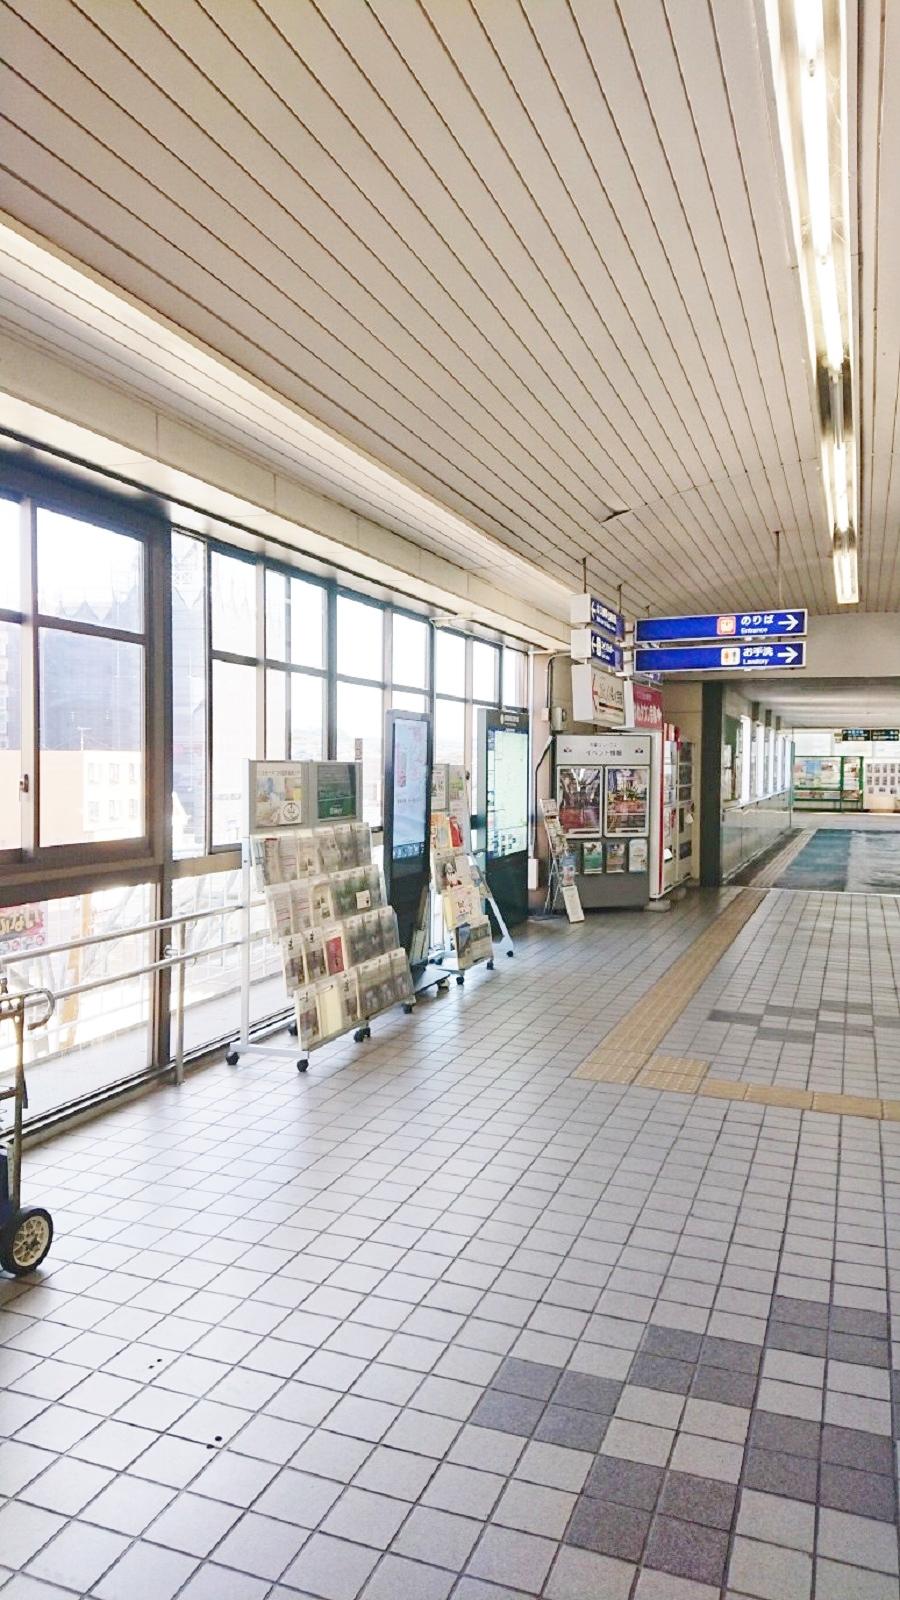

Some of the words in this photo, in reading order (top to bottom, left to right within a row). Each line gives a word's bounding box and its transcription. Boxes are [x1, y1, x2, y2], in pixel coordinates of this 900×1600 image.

[741, 614, 775, 626] のりば
[743, 646, 774, 657] お手洗
